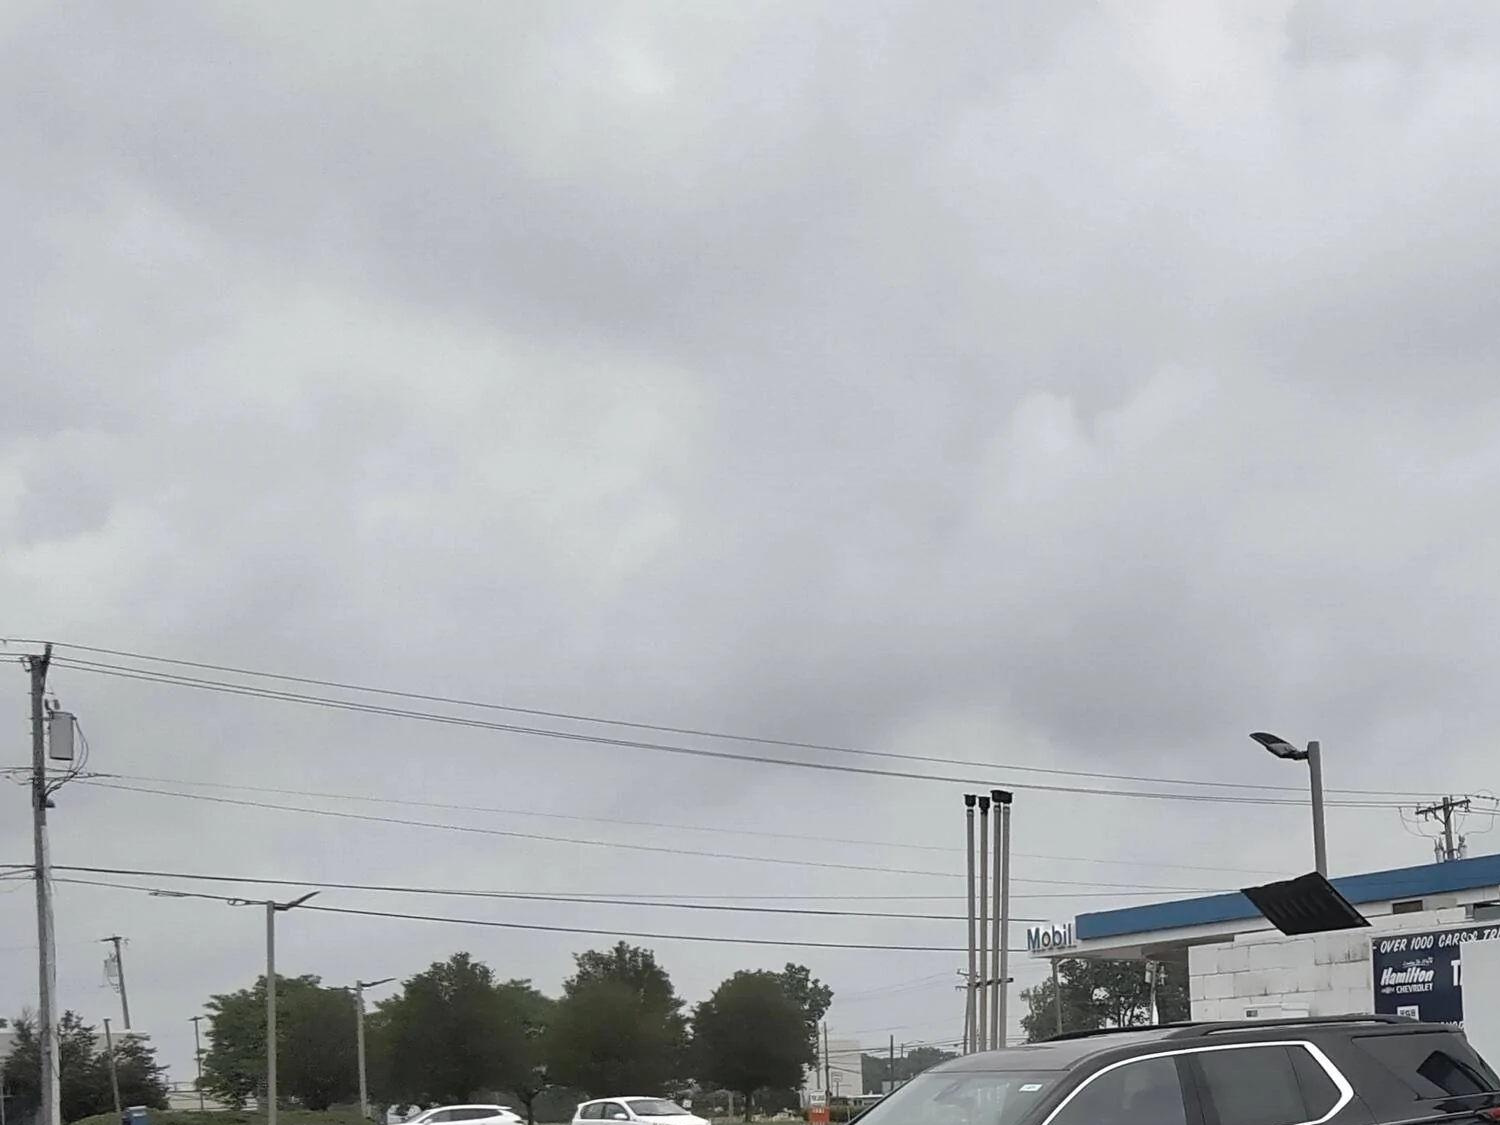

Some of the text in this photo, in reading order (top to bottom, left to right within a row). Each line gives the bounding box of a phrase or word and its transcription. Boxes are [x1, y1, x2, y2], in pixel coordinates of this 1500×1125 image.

[1027, 923, 1072, 950] Mobil
[1380, 937, 1408, 954] OVER
[1410, 935, 1434, 951] 1000
[1438, 932, 1467, 948] CARS
[1380, 966, 1434, 986] Hamilton
[1396, 983, 1434, 994] CHEVROLET
